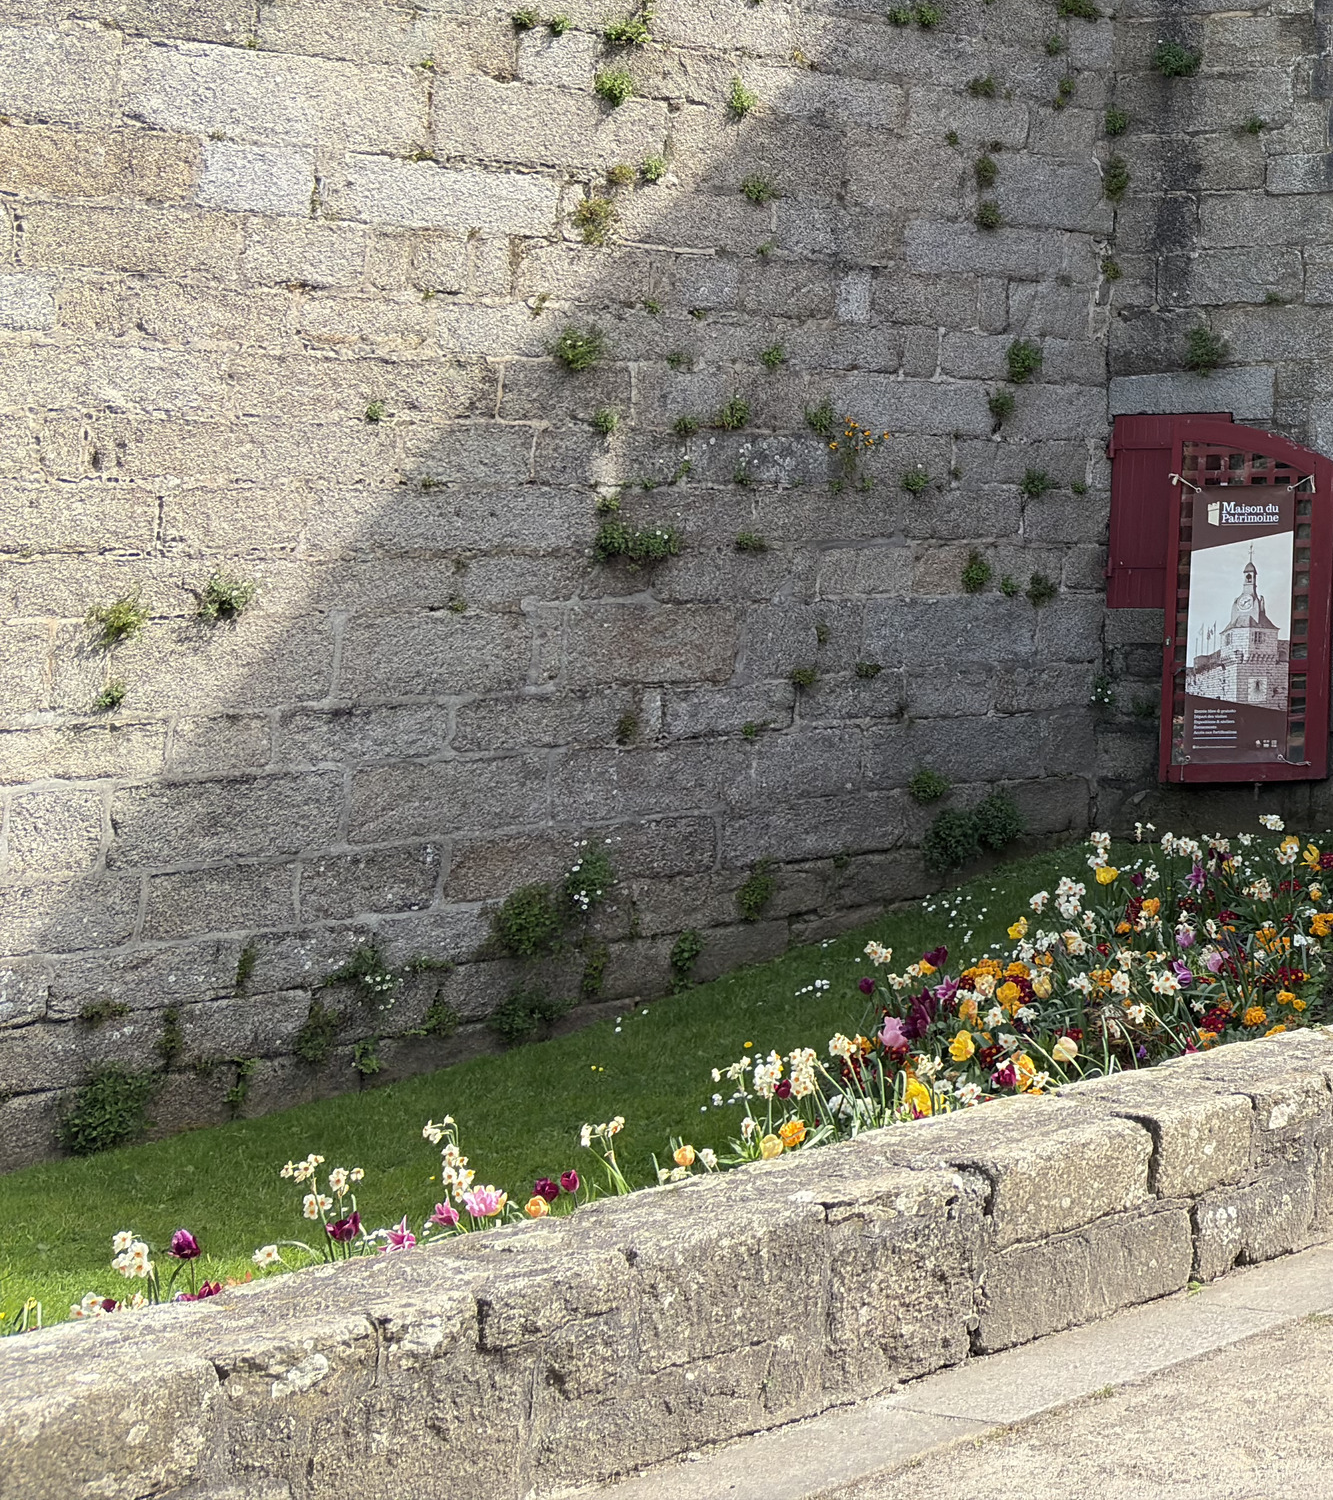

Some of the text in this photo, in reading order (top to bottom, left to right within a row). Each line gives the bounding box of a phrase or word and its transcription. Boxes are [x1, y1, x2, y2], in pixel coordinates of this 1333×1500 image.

[1222, 501, 1279, 513] Maison du
[1221, 513, 1280, 523] Patrimoine
